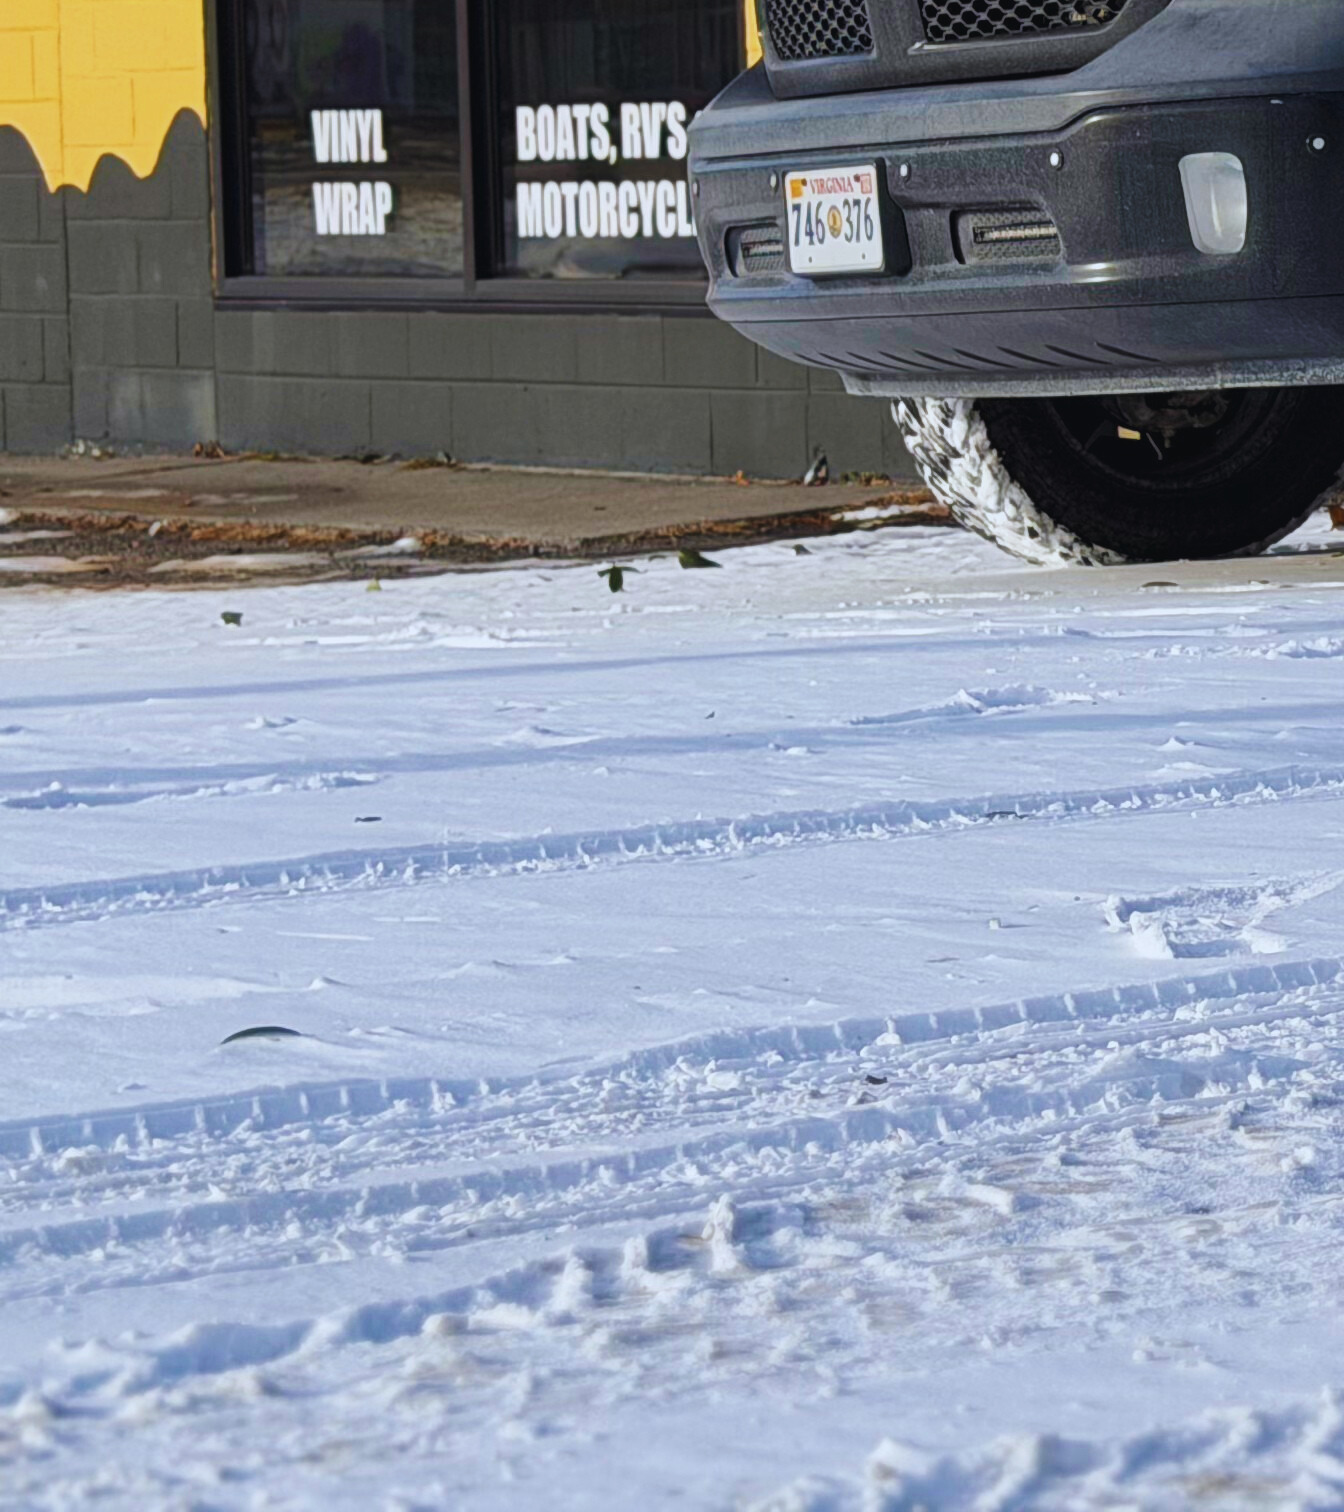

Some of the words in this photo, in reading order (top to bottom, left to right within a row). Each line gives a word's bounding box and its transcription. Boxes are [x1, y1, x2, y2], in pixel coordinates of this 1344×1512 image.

[311, 108, 388, 163] VINYL
[516, 102, 618, 165] BOATS,
[620, 101, 688, 160] RV'S
[313, 181, 393, 235] WRAP
[516, 179, 698, 239] MOTORCYCL
[809, 176, 854, 195] VIRGINIA
[791, 200, 826, 247] 746
[842, 196, 874, 243] 376
